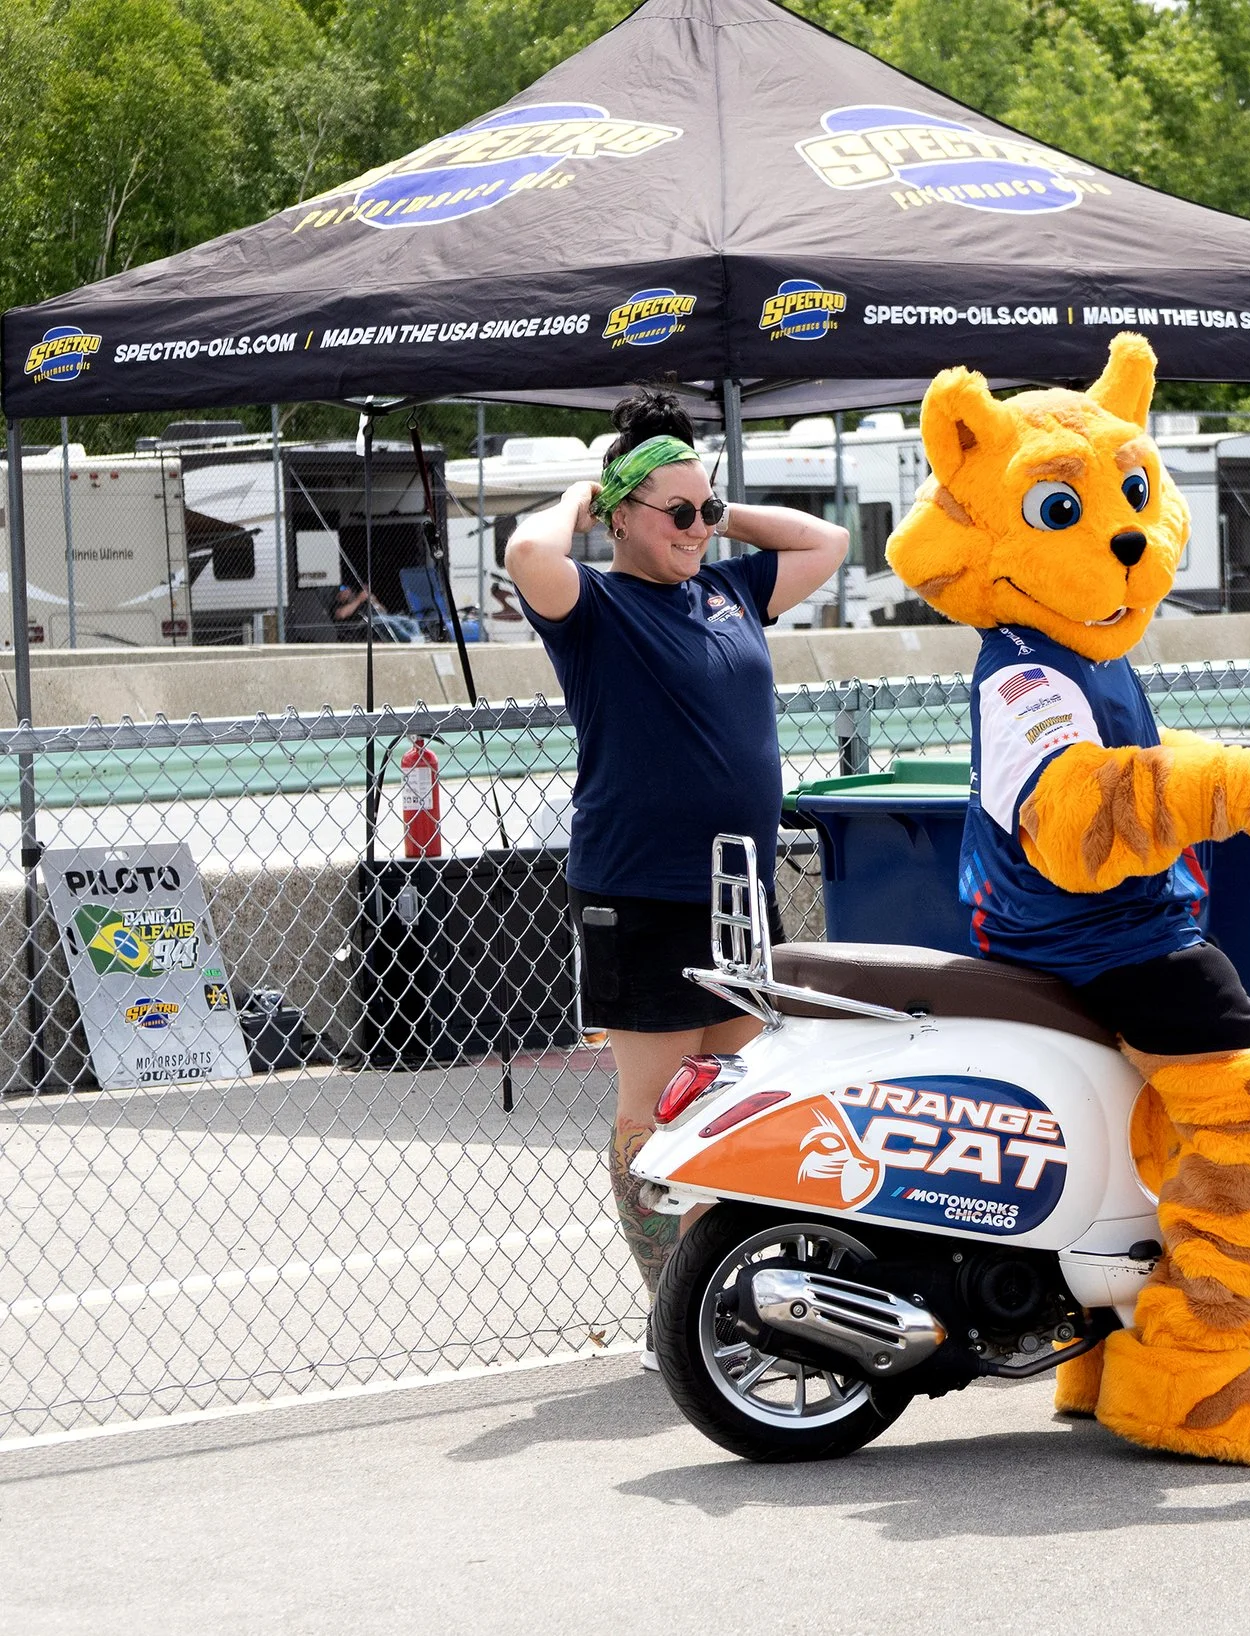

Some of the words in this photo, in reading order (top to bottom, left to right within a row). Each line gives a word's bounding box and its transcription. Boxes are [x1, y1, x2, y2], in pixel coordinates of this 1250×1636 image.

[308, 120, 670, 202] SPECTRO
[802, 127, 1094, 187] SPECTRO
[605, 296, 697, 337] SPECTRO
[760, 291, 846, 329] SPECTRO
[863, 304, 1058, 325] SPECTRO-OILS.COM
[1083, 306, 1137, 325] MADE
[1139, 307, 1159, 325] IN
[1159, 308, 1199, 327] THE
[1200, 309, 1239, 329] USA
[26, 334, 102, 373] SPECTRO
[113, 332, 298, 363] SPECTRO-OILS.COM
[320, 329, 375, 349] MADE
[374, 325, 398, 345] IN
[400, 322, 440, 344] THE
[438, 320, 477, 342] USA
[479, 317, 542, 340] SINCE
[539, 313, 591, 336] 1966
[99, 547, 134, 561] Winnie
[65, 865, 181, 897] PILOTO
[140, 922, 194, 940] LEWIS
[152, 937, 198, 970] 94
[136, 1051, 212, 1070] MOTORSPORTS
[835, 1082, 1060, 1141] ORANGE
[862, 1116, 1068, 1191] CAT
[907, 1188, 1019, 1218] MOTOWORKS
[943, 1207, 1017, 1229] CHICAGO
